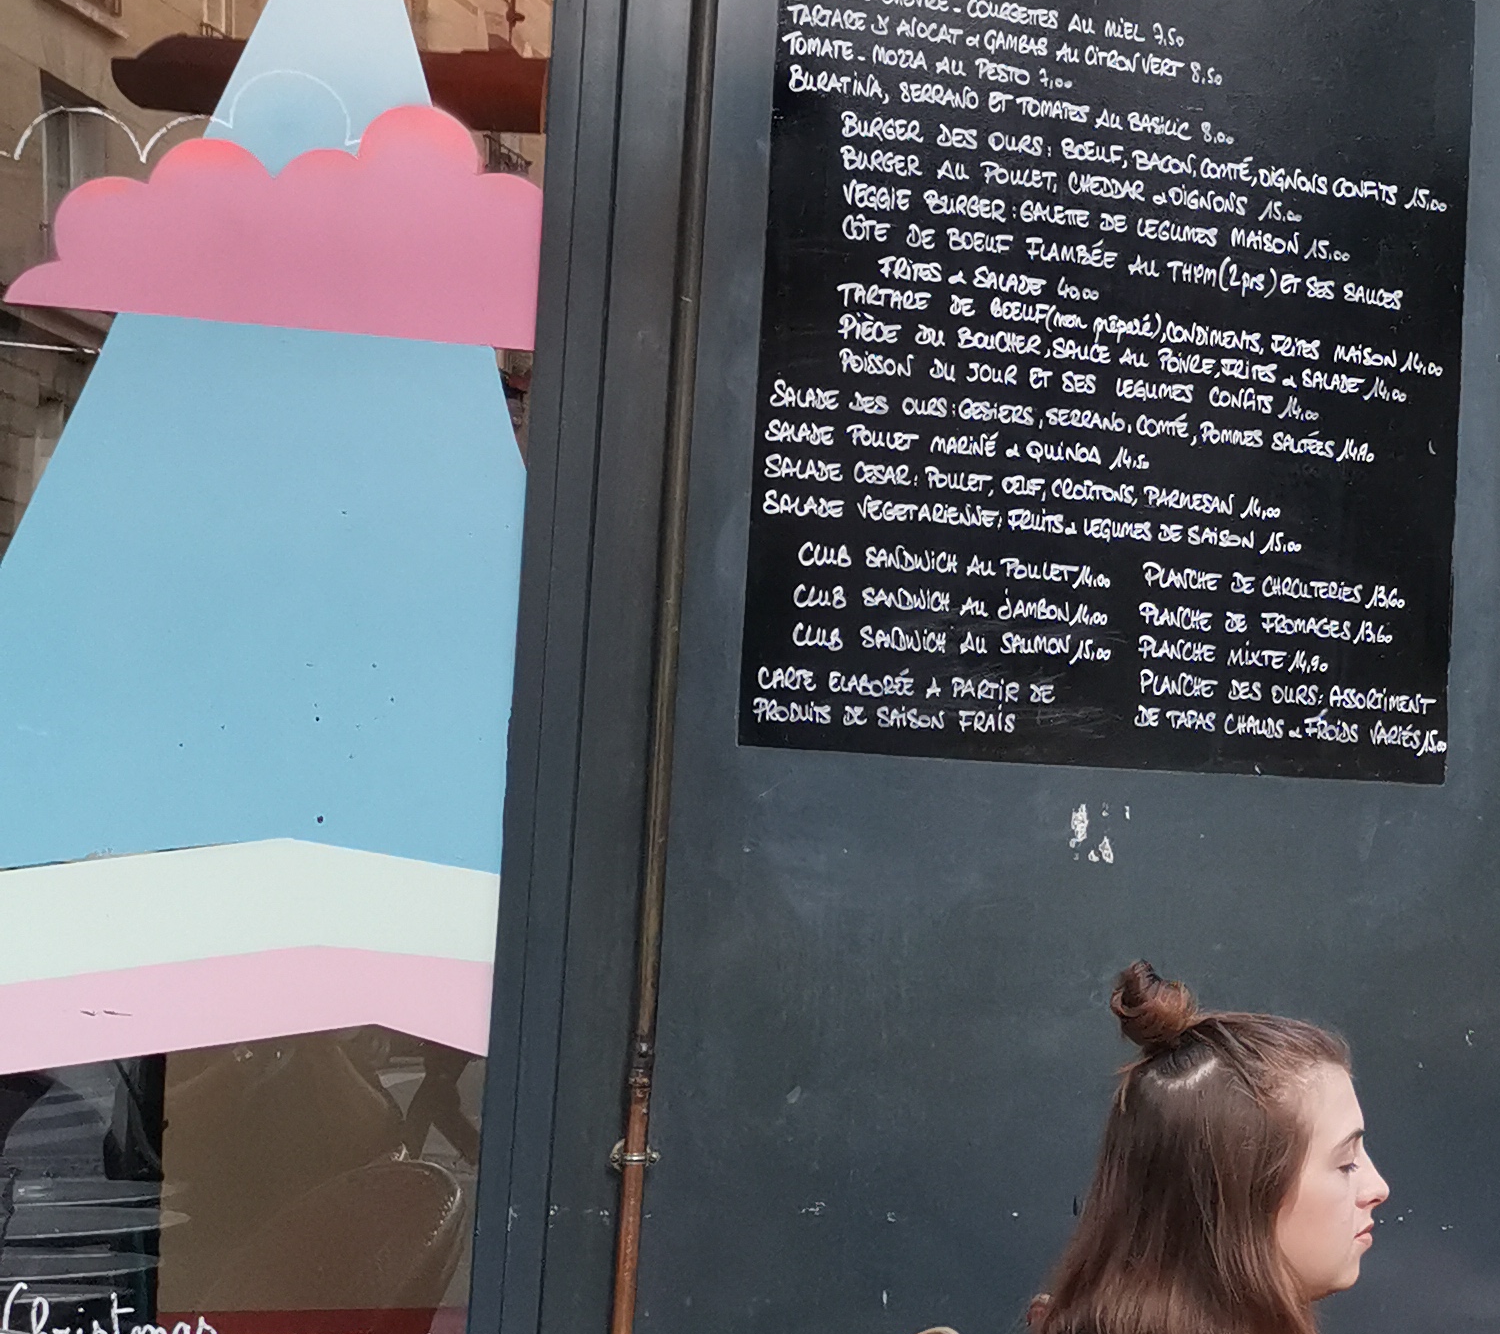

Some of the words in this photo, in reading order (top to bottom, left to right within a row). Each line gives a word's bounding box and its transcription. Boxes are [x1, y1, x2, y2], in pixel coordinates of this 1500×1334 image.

[788, 4, 867, 32] TARTARE
[984, 30, 1048, 57] GAMBAS
[1056, 43, 1080, 64] AU
[1068, 13, 1096, 35] AU
[936, 57, 967, 77] AU
[975, 58, 1031, 86] PESTO
[899, 82, 979, 110] SERRANO
[989, 92, 1015, 113] ET
[1016, 97, 1090, 123] TOMATES
[1095, 109, 1124, 131] AU
[1128, 112, 1193, 141] BASILIC
[840, 145, 923, 177] BURGER
[937, 160, 970, 181] AU
[1069, 172, 1146, 202] CHEDDAR
[1168, 184, 1248, 216] OIGNONS
[841, 111, 924, 143] BURGER
[937, 124, 978, 150] DES
[1332, 178, 1398, 206] CONFITS
[843, 179, 912, 212] VEGGIE
[1100, 213, 1128, 233] DE
[1137, 218, 1218, 248] LEGUMES
[1231, 228, 1300, 255] MAISON
[842, 214, 892, 242] CÔTE
[906, 224, 936, 250] DE
[947, 228, 1014, 254] BOEUF
[1026, 237, 1119, 269] FLAMBÉE
[1128, 255, 1160, 278] AU
[1280, 274, 1303, 295] ET
[1306, 276, 1336, 300] SES
[1344, 283, 1404, 311] SAUCES
[878, 256, 943, 283] FRITES
[973, 266, 1048, 296] SALADE
[837, 283, 932, 311] TARTARE
[950, 295, 976, 317] DE
[1334, 344, 1398, 368] MAISON
[838, 312, 903, 344] PIÈCE
[915, 324, 946, 348] DU
[1053, 337, 1112, 364] SAUCE
[1119, 348, 1150, 368] AU
[1302, 368, 1365, 394] SALADE
[839, 348, 915, 377] POISSON
[930, 358, 956, 383] DU
[966, 363, 1018, 386] JOUR
[1030, 368, 1053, 390] ET
[1062, 371, 1097, 395] SES
[1116, 378, 1195, 404] LEGUMES
[1209, 386, 1274, 414] CONFITS
[765, 419, 835, 446] SALADE
[847, 424, 920, 452] POULET
[930, 432, 999, 458] MARINÉ
[1026, 441, 1102, 466] QUINOA
[770, 379, 840, 411] SALADE
[849, 392, 890, 415] DES
[1200, 421, 1264, 448] POMMES
[1272, 431, 1336, 459] SAUTÉES
[765, 454, 844, 482] SALADE
[1144, 486, 1235, 516] PARMESAN
[763, 490, 845, 518] SALADE
[1008, 509, 1064, 534] FRUITS
[1084, 519, 1153, 543] LEGUMES
[1158, 524, 1184, 543] DE
[1188, 525, 1255, 550] SAISON
[798, 542, 852, 568] CLUB
[866, 545, 958, 574] SANDWICH
[967, 555, 997, 577] AU
[1000, 557, 1079, 583] POULET
[1143, 562, 1223, 591] PLANCHE
[1231, 572, 1256, 595] DE
[794, 584, 847, 610] CLUB
[862, 587, 950, 613] SANDWICH
[960, 597, 989, 618] AU
[998, 589, 1070, 622] JAMBON
[1139, 602, 1213, 632] PLANCHE
[1225, 612, 1248, 633] DE
[1261, 613, 1352, 641] FROMAGES
[793, 623, 844, 652] CLUB
[860, 625, 947, 654] SANDWICH
[960, 632, 988, 655] AU
[1000, 632, 1072, 655] SAUMON
[1138, 635, 1217, 662] PLANCHE
[1228, 641, 1288, 670] MIXTE
[758, 666, 817, 692] CARTE
[829, 669, 915, 698] ELABORÉE
[926, 677, 942, 699] A
[952, 677, 1020, 703] PARTIR
[1030, 684, 1056, 704] DE
[1140, 669, 1219, 698] PLANCHE
[1229, 679, 1262, 702] DES
[1329, 685, 1437, 716] ASSORTIMENT
[754, 697, 832, 725] PRODUITS
[843, 706, 868, 726] DE
[877, 706, 946, 730] SAISON
[959, 704, 1016, 734] FRAIS
[1134, 705, 1161, 727] DE
[1166, 710, 1217, 732] TAPAS
[1225, 713, 1285, 739] CHAUDS
[1304, 708, 1359, 744] FROIDS
